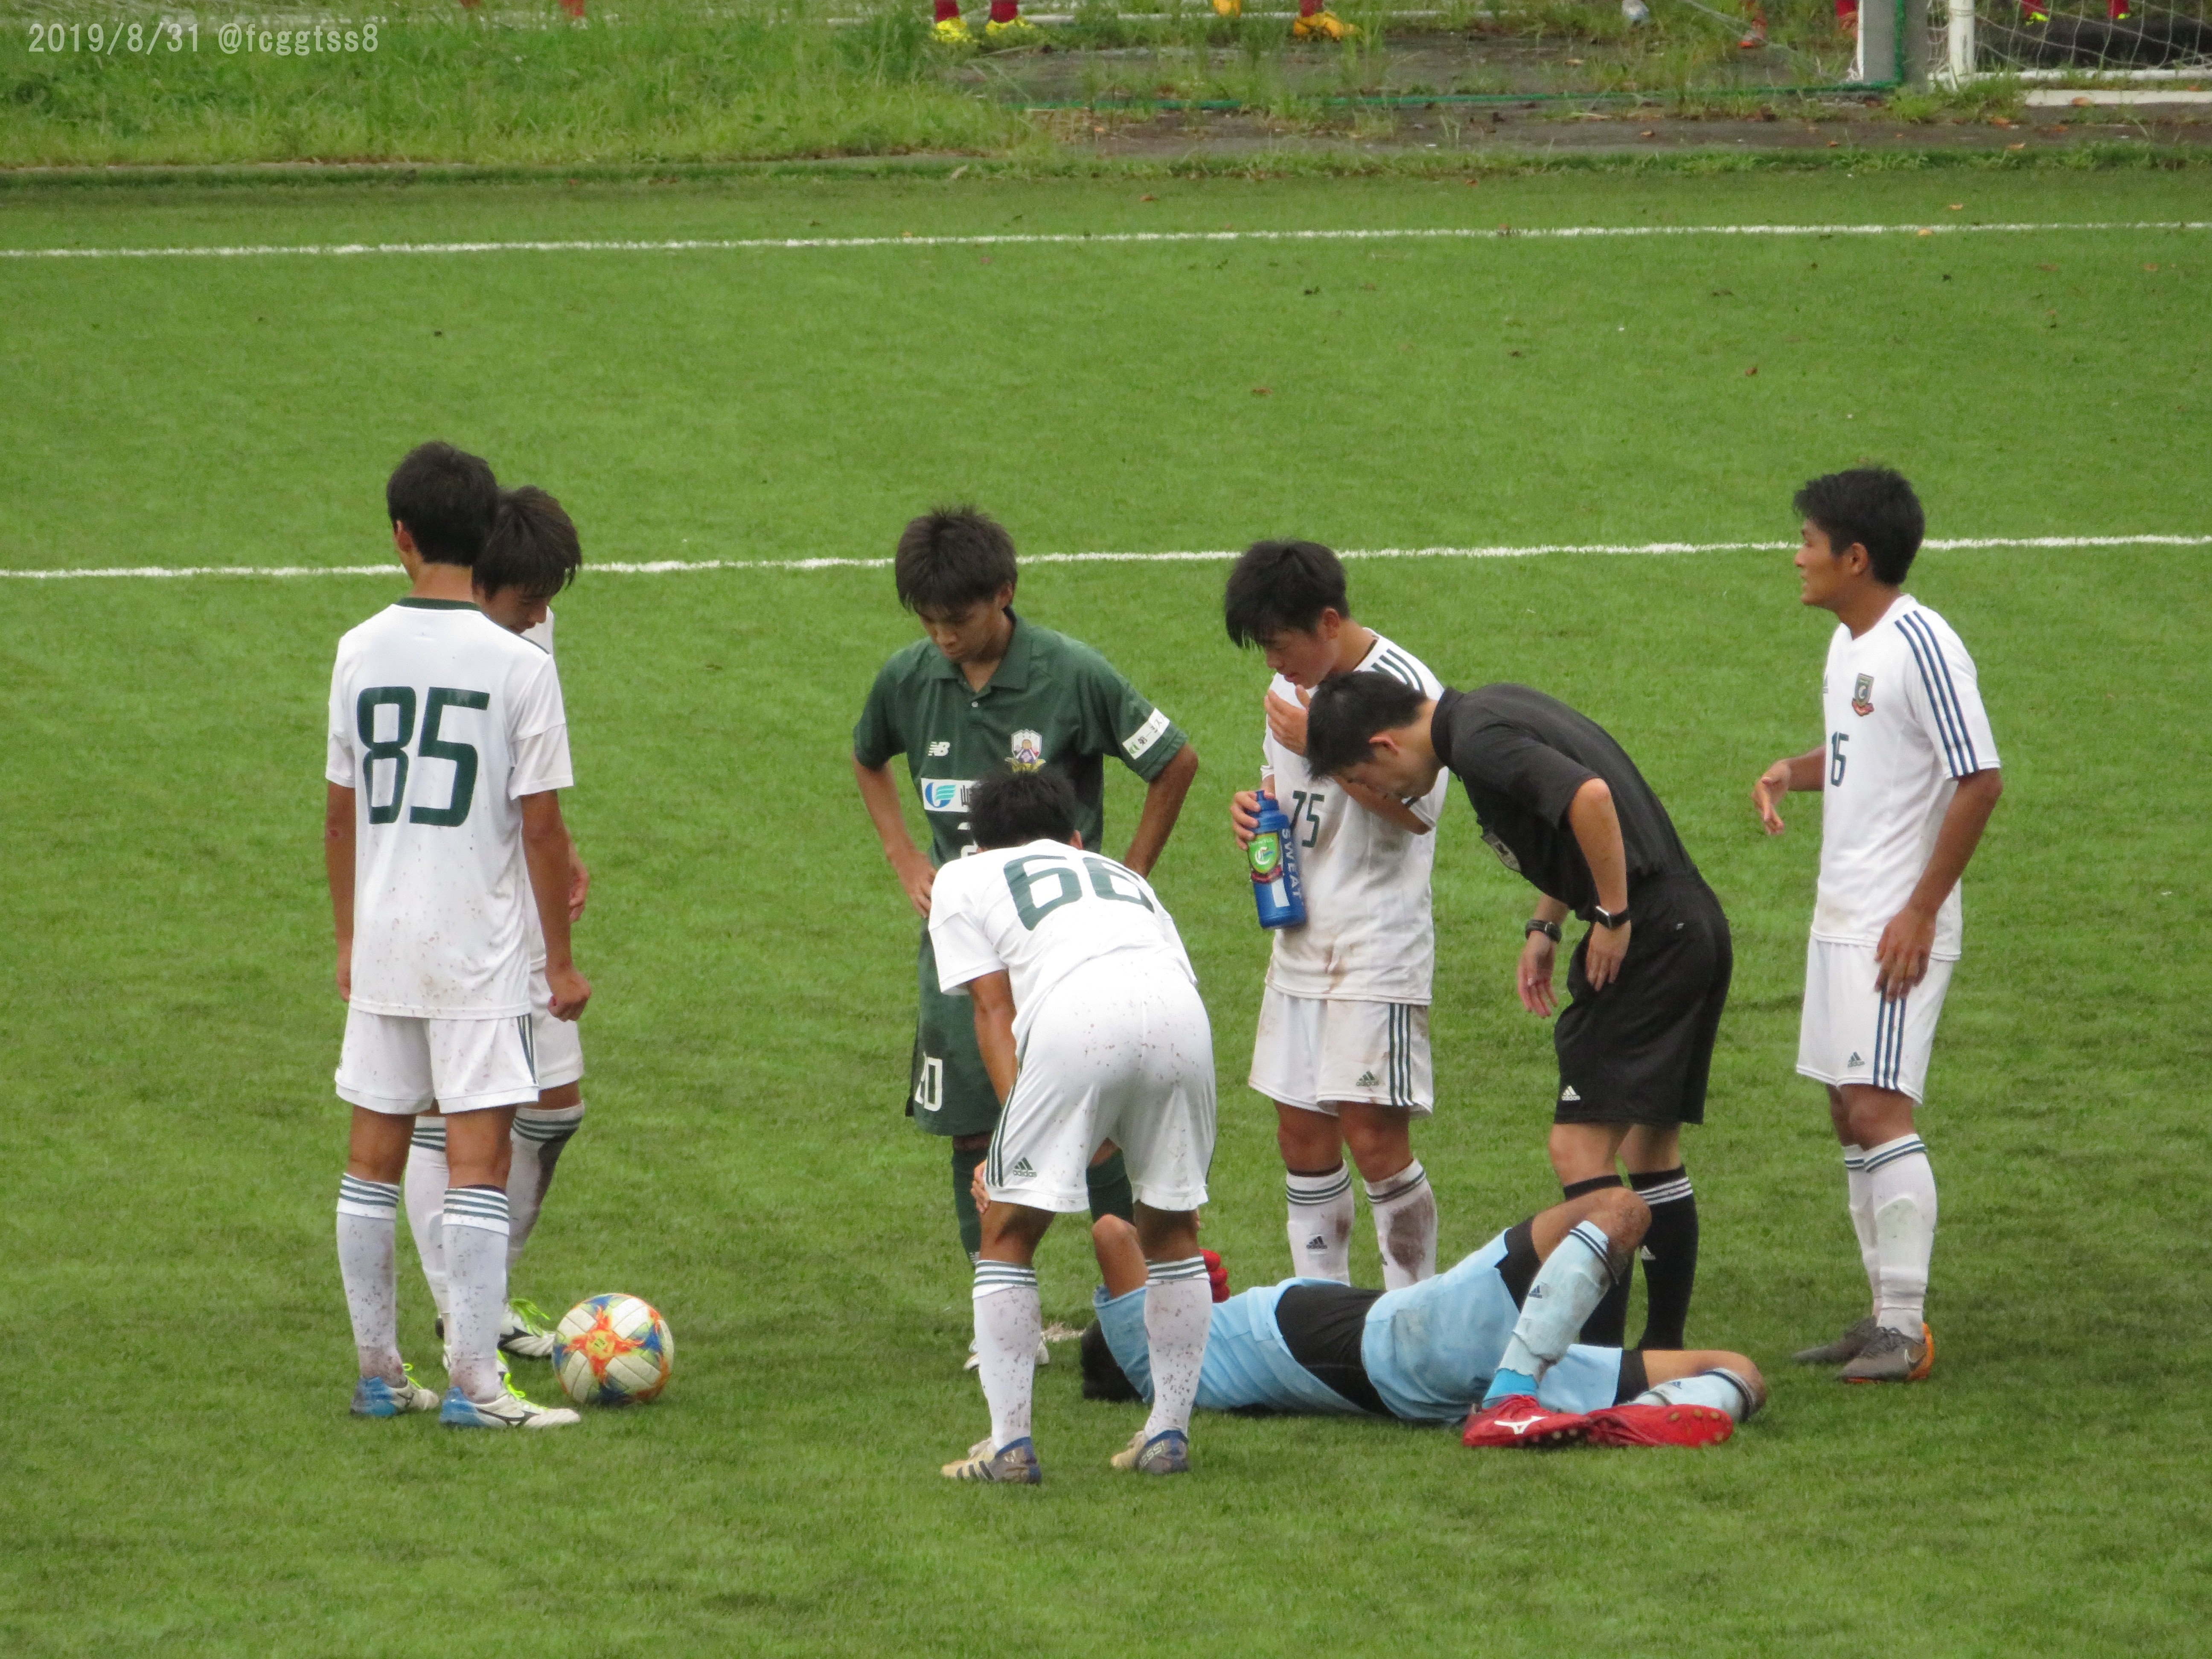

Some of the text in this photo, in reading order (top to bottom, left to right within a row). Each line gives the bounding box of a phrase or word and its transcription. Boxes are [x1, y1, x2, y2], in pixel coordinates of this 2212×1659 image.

[357, 686, 490, 827] 85
[1292, 790, 1325, 848] 75
[1003, 854, 1155, 931] 66
